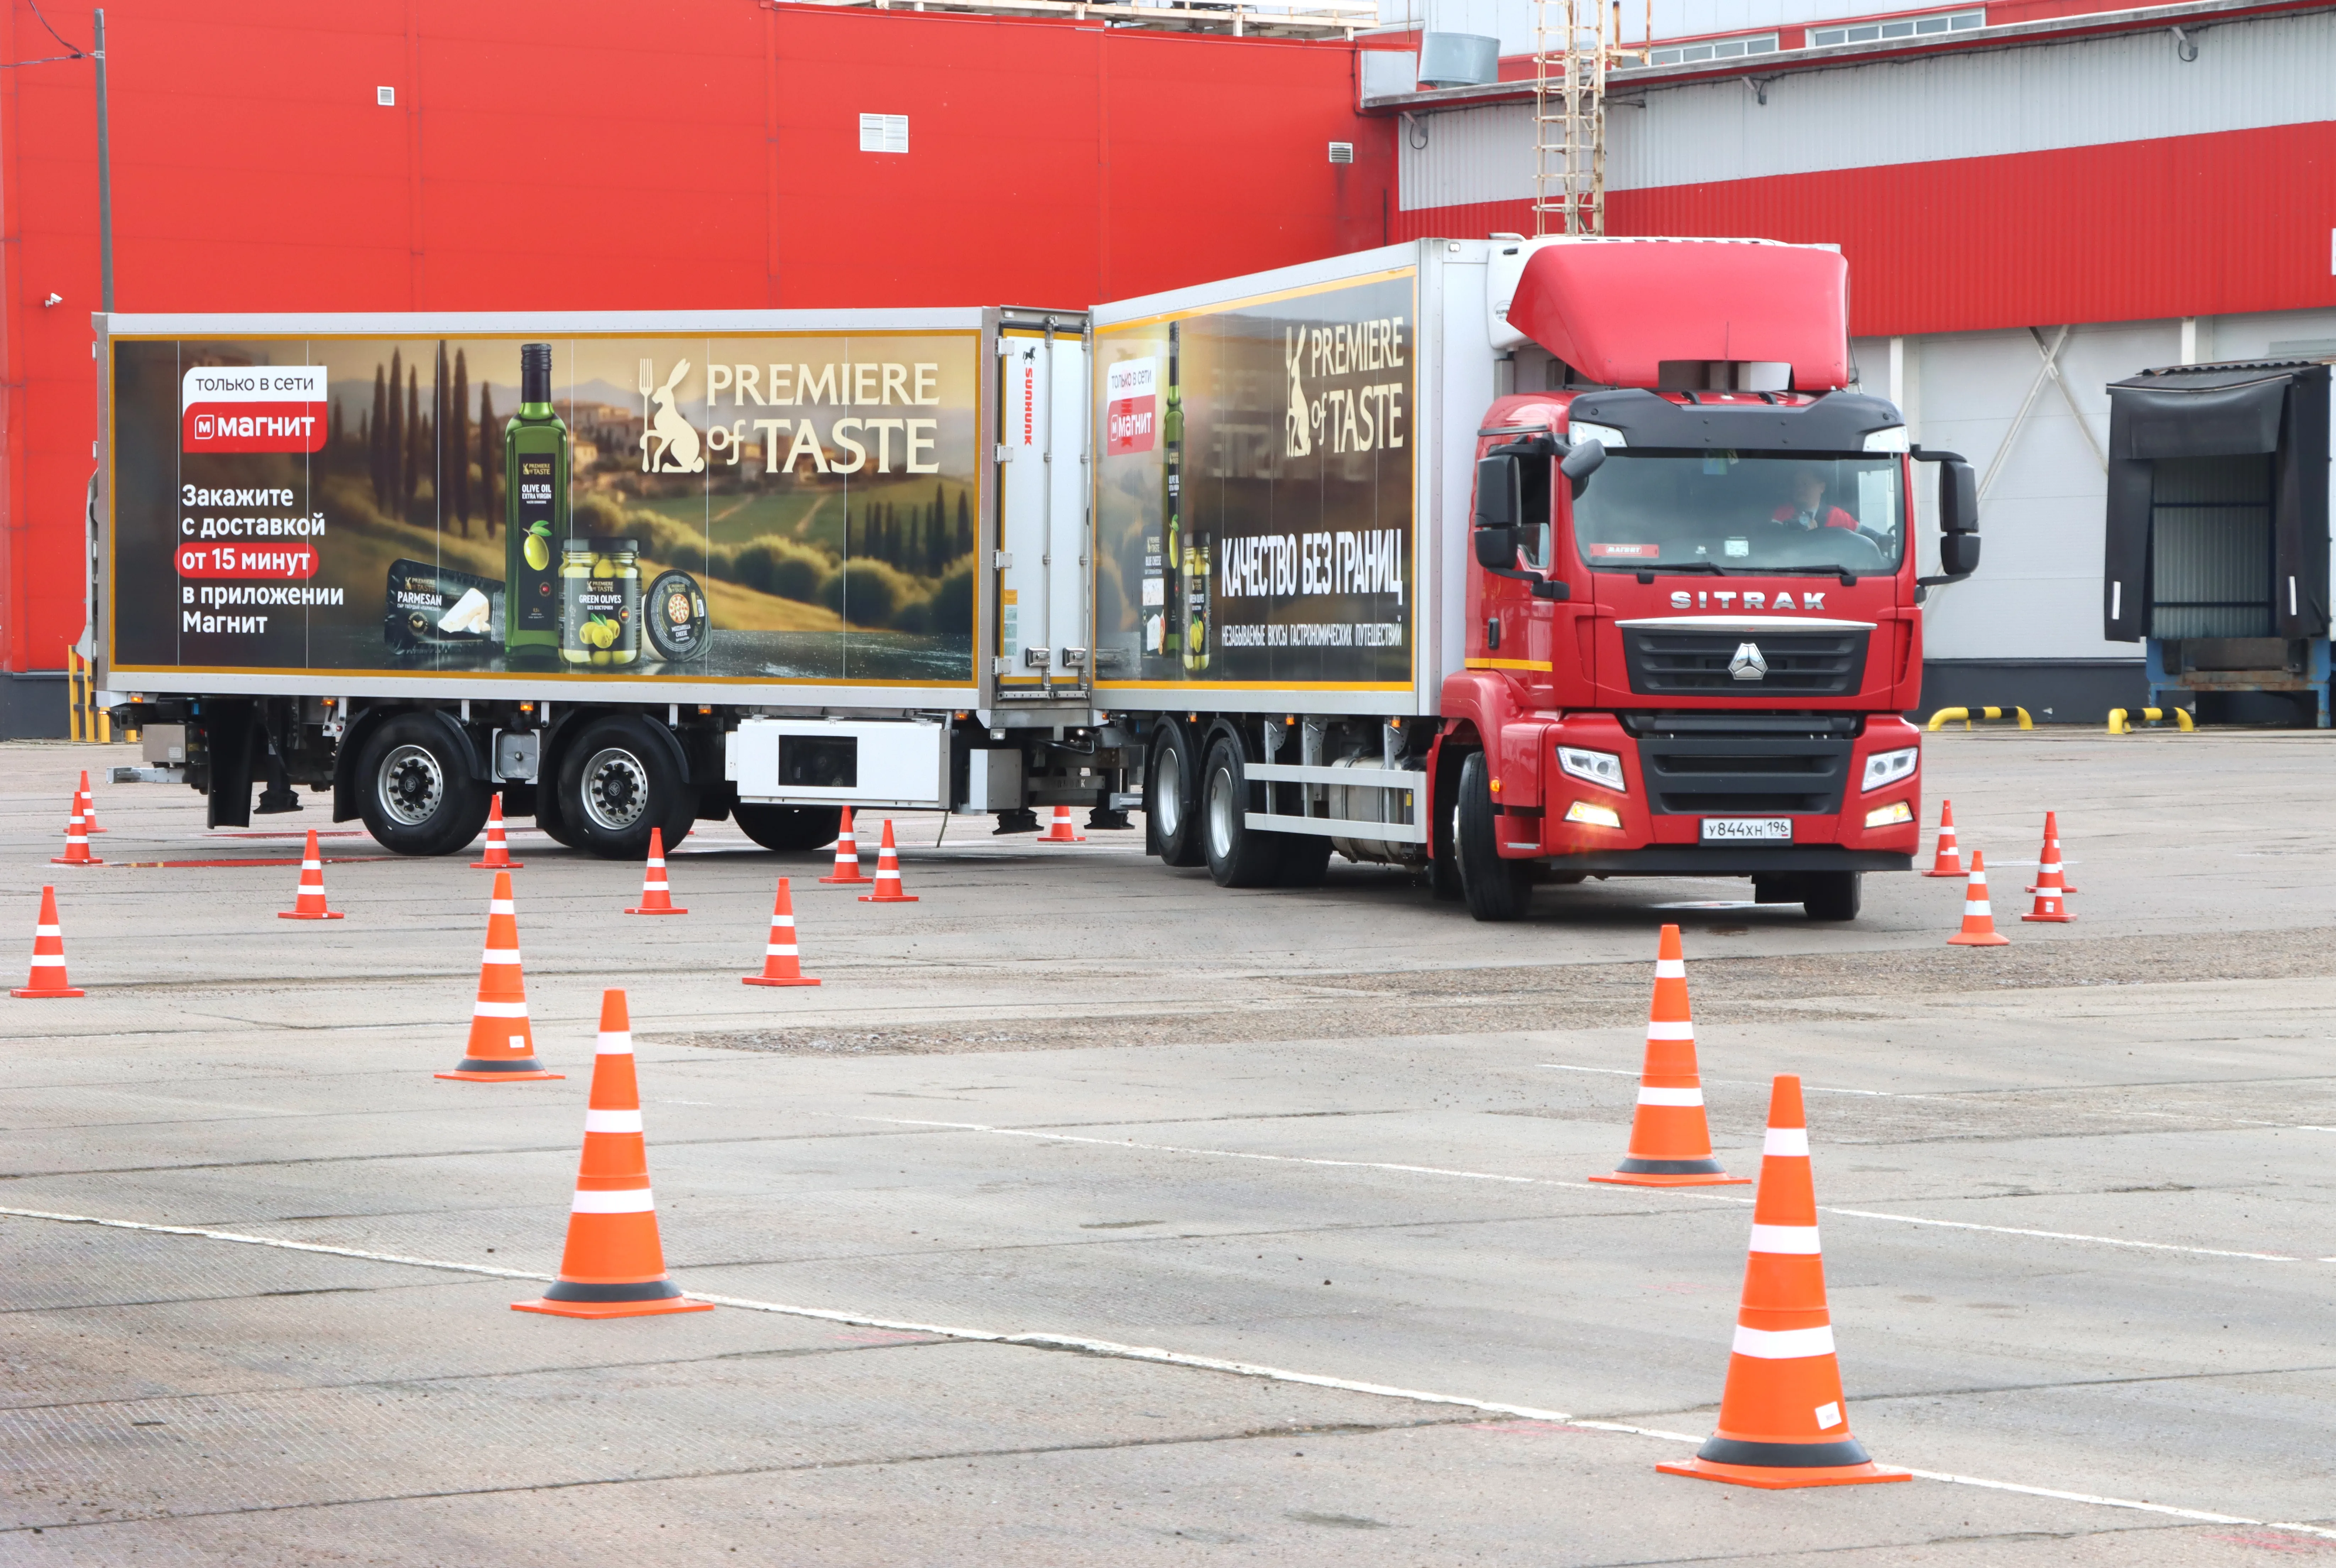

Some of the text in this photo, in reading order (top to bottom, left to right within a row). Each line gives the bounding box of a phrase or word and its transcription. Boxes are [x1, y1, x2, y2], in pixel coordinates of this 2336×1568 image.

[1312, 316, 1404, 377] PREMIERE
[196, 378, 313, 391] только в сети
[707, 363, 940, 406] PREMIERE
[1112, 370, 1151, 389] только в сети
[218, 417, 315, 437] магнит
[1311, 382, 1404, 453] of TASTE
[707, 418, 940, 474] of TASTE
[182, 484, 293, 506] Закажите
[522, 484, 552, 493] OLIVE OIL
[182, 513, 325, 539] с доставкой
[182, 548, 311, 576] от 15 минут
[1222, 529, 1402, 605] КАЧЕСТВО БЕЗ ГРАНИЦ
[183, 587, 343, 609] в приложении
[397, 591, 442, 606] PARMESAN
[579, 595, 621, 603] GREEN OLIVES
[1670, 591, 1826, 610] SITRAK
[183, 611, 267, 633] Магнит
[1222, 615, 1402, 646] НЕЗАБЫВАЕМЫЕ ВКУСЫ ГАСТРОНОМИЧЕСКИХ ПУТЕШЕСТВИЙ
[1767, 821, 1787, 832] 196
